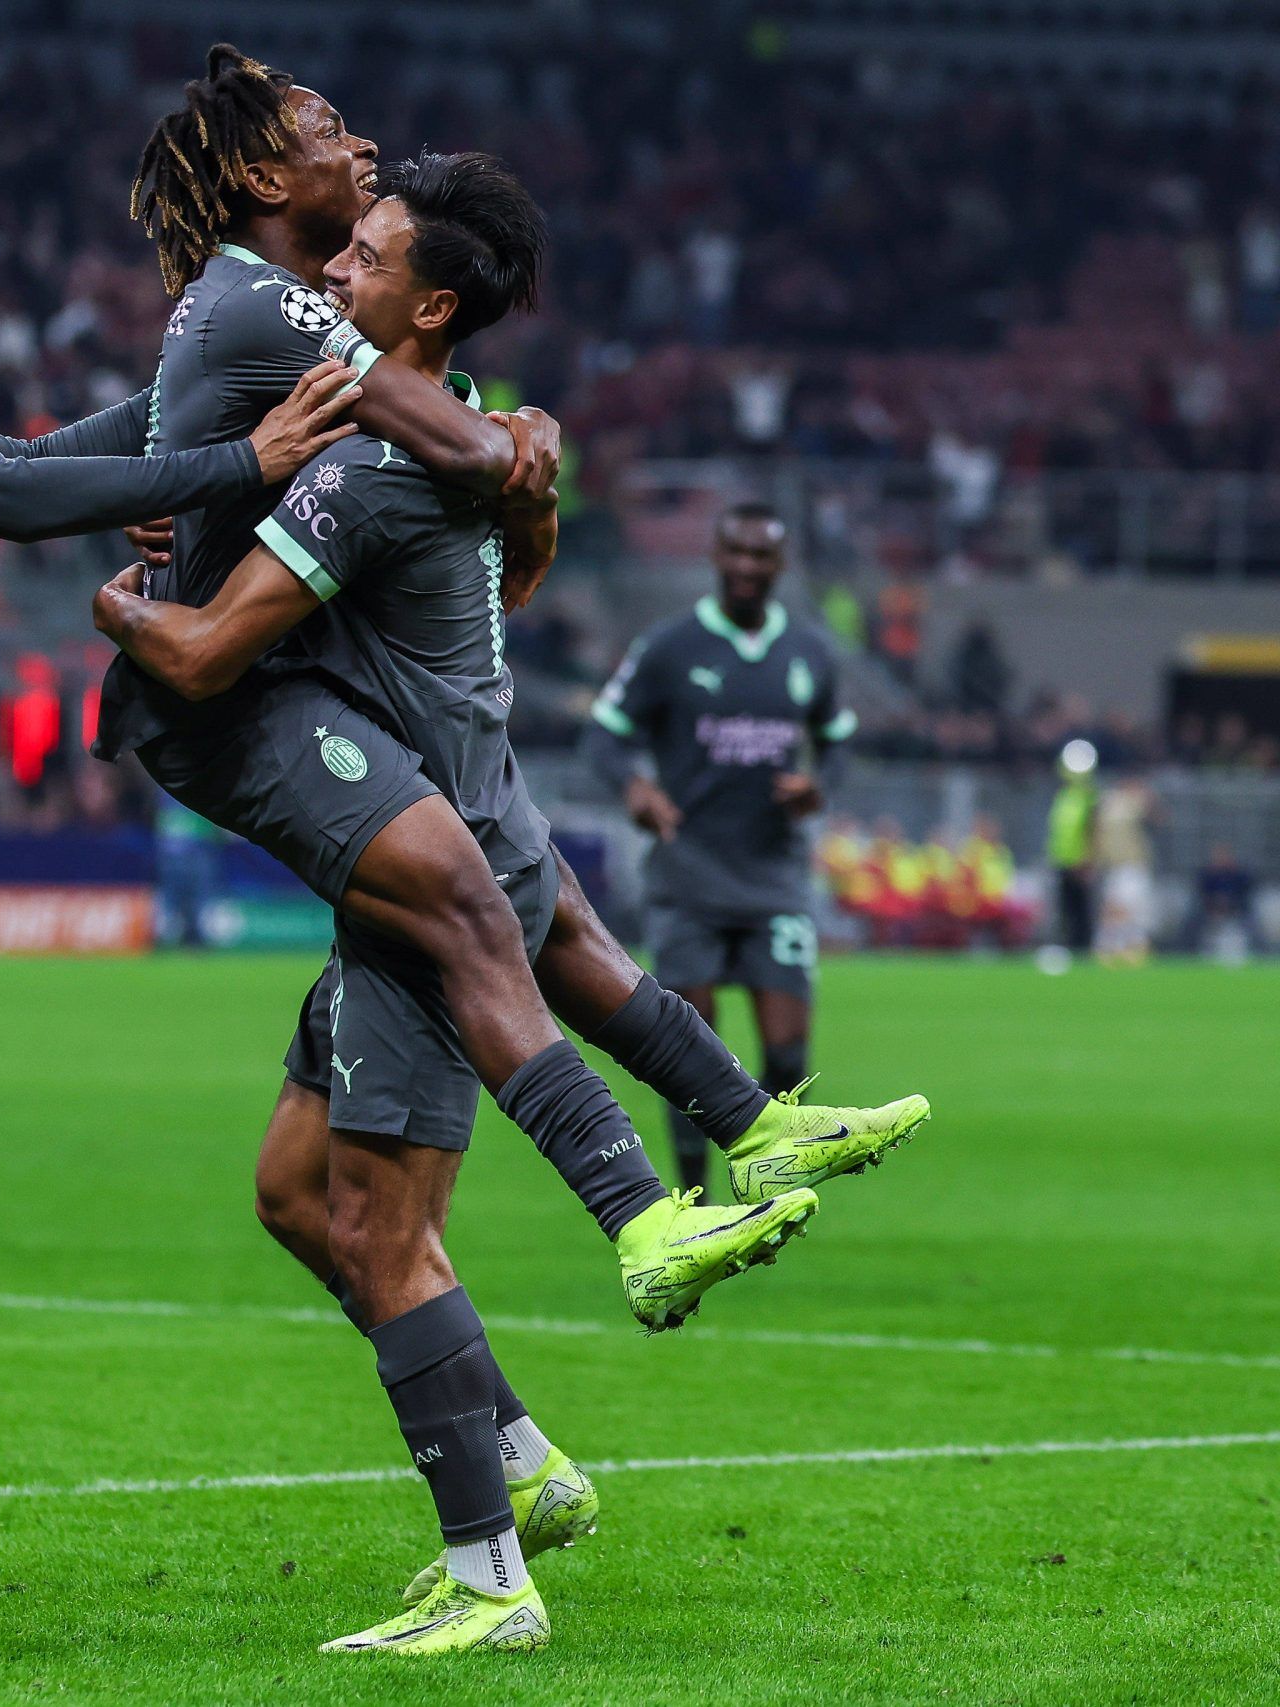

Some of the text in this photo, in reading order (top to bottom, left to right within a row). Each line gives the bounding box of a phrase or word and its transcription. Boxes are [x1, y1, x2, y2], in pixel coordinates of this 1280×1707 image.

[283, 475, 339, 541] MSC
[599, 1133, 643, 1162] MILA
[487, 1536, 511, 1590] ESIGN
